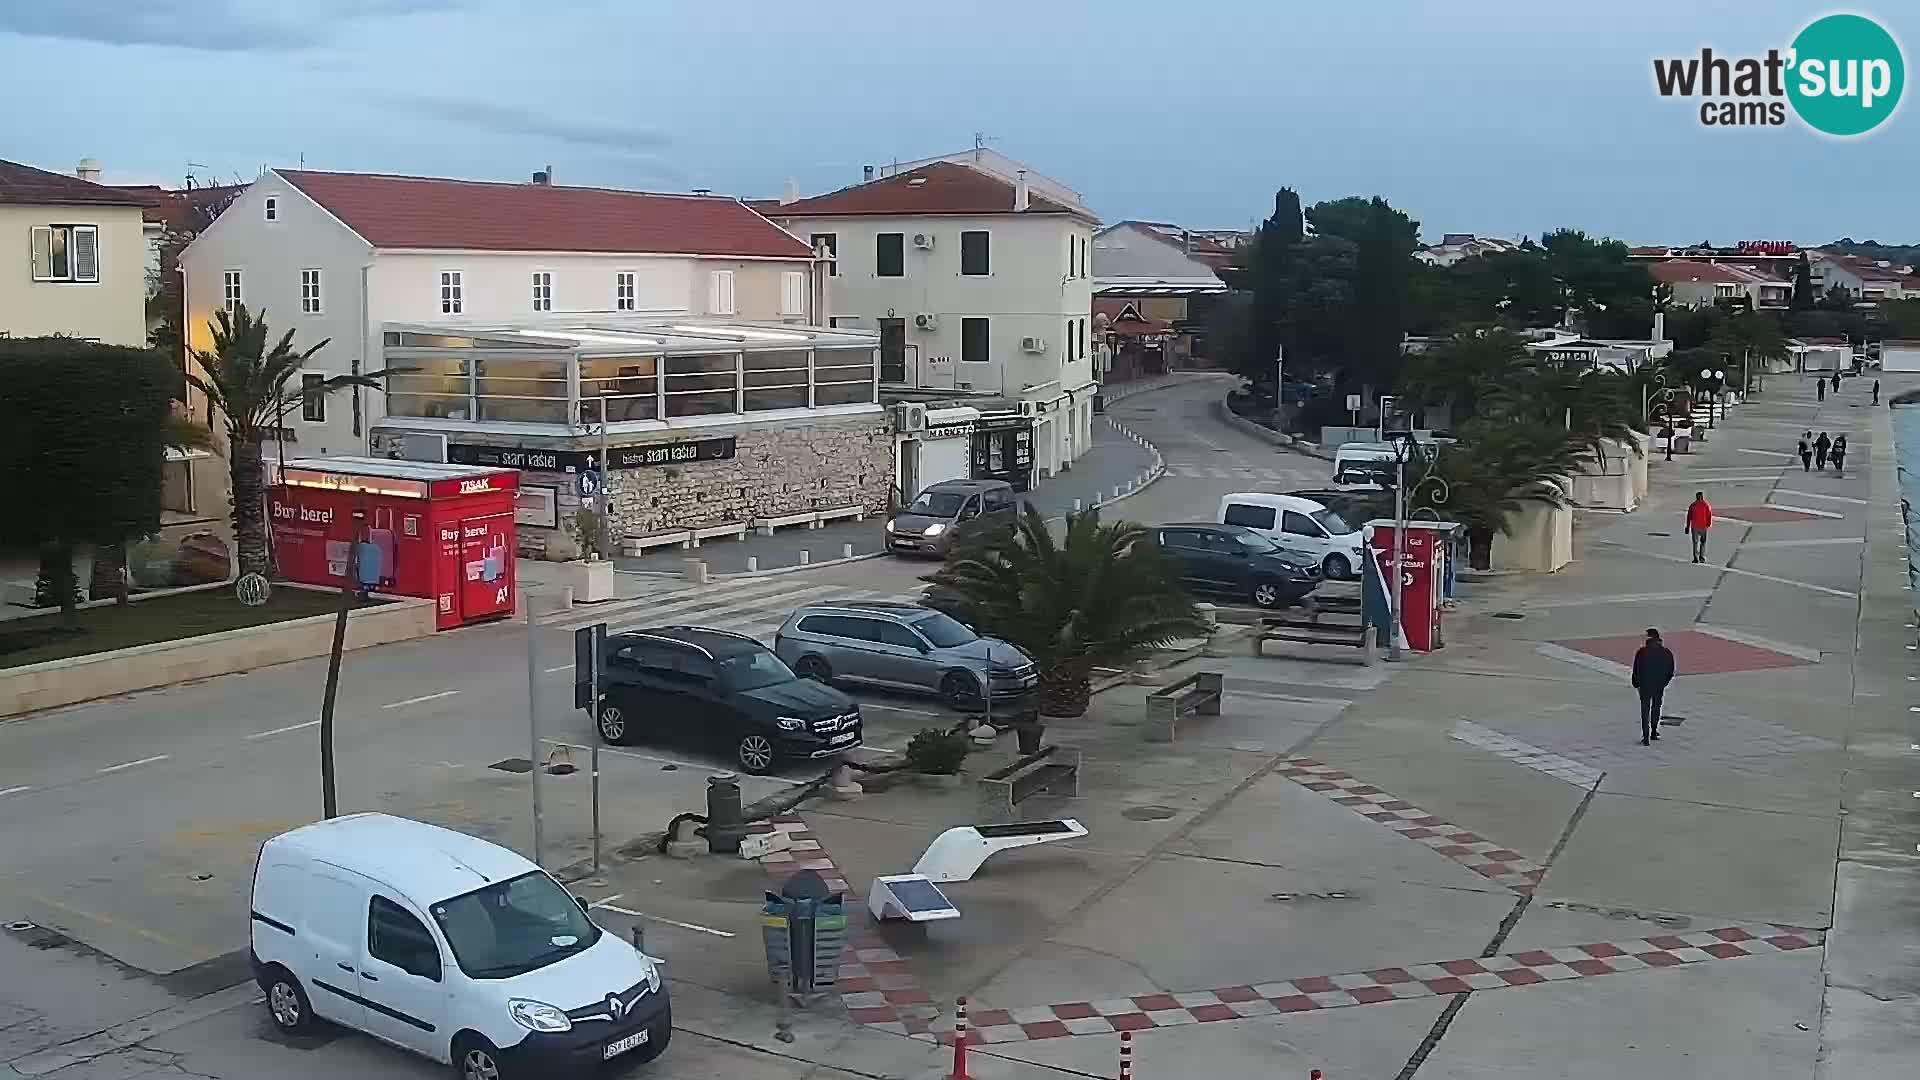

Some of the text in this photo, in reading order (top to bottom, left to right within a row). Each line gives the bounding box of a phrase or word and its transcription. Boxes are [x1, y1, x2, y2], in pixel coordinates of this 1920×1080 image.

[460, 478, 489, 492] TISAK
[273, 501, 333, 523] Buy here!
[441, 529, 460, 542] Buy
